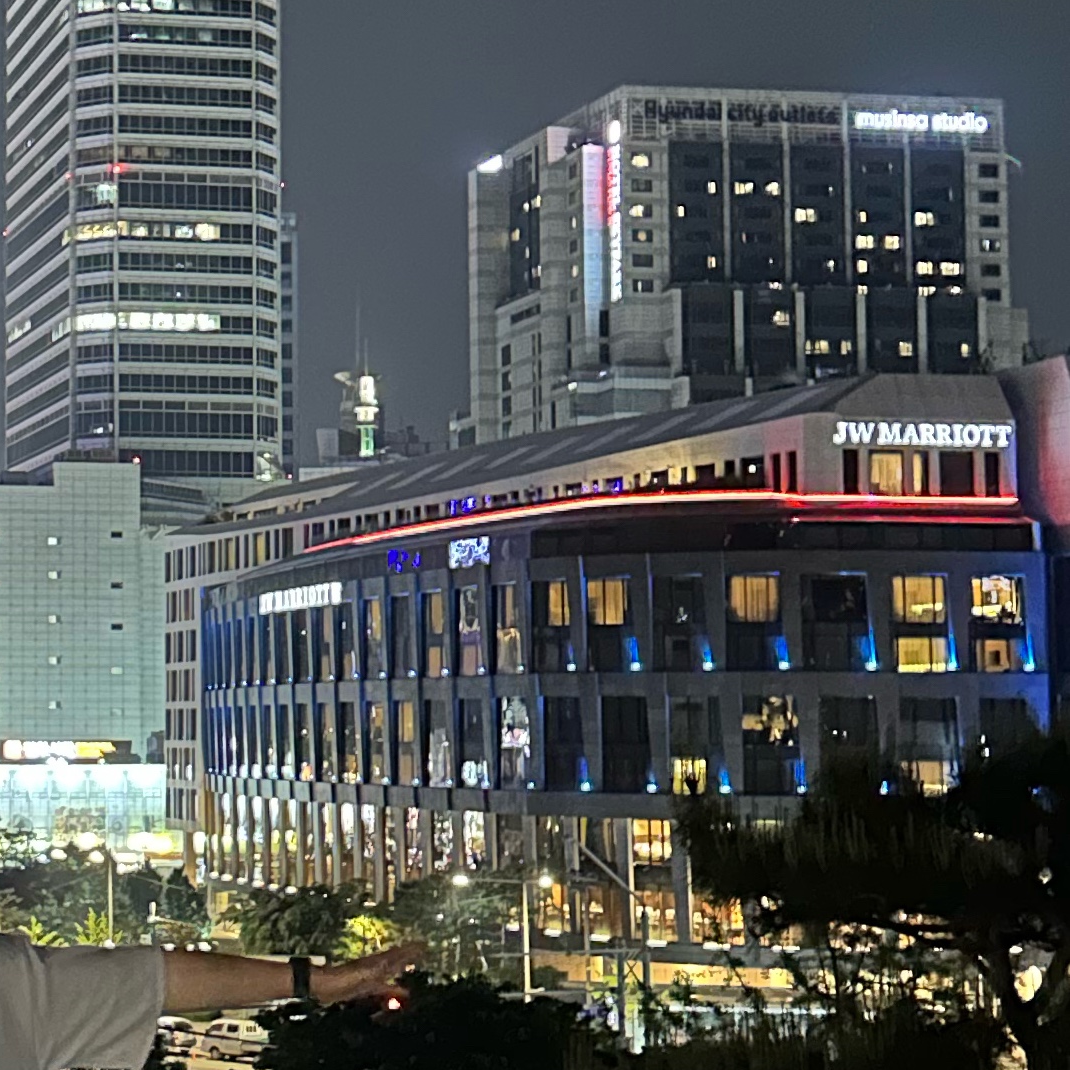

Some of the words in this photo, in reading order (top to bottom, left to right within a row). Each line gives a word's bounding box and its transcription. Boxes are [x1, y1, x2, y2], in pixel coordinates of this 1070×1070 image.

[854, 107, 929, 132] musinsa
[931, 111, 989, 134] studio
[832, 421, 875, 445] JW
[876, 421, 1012, 448] MARRIOTT
